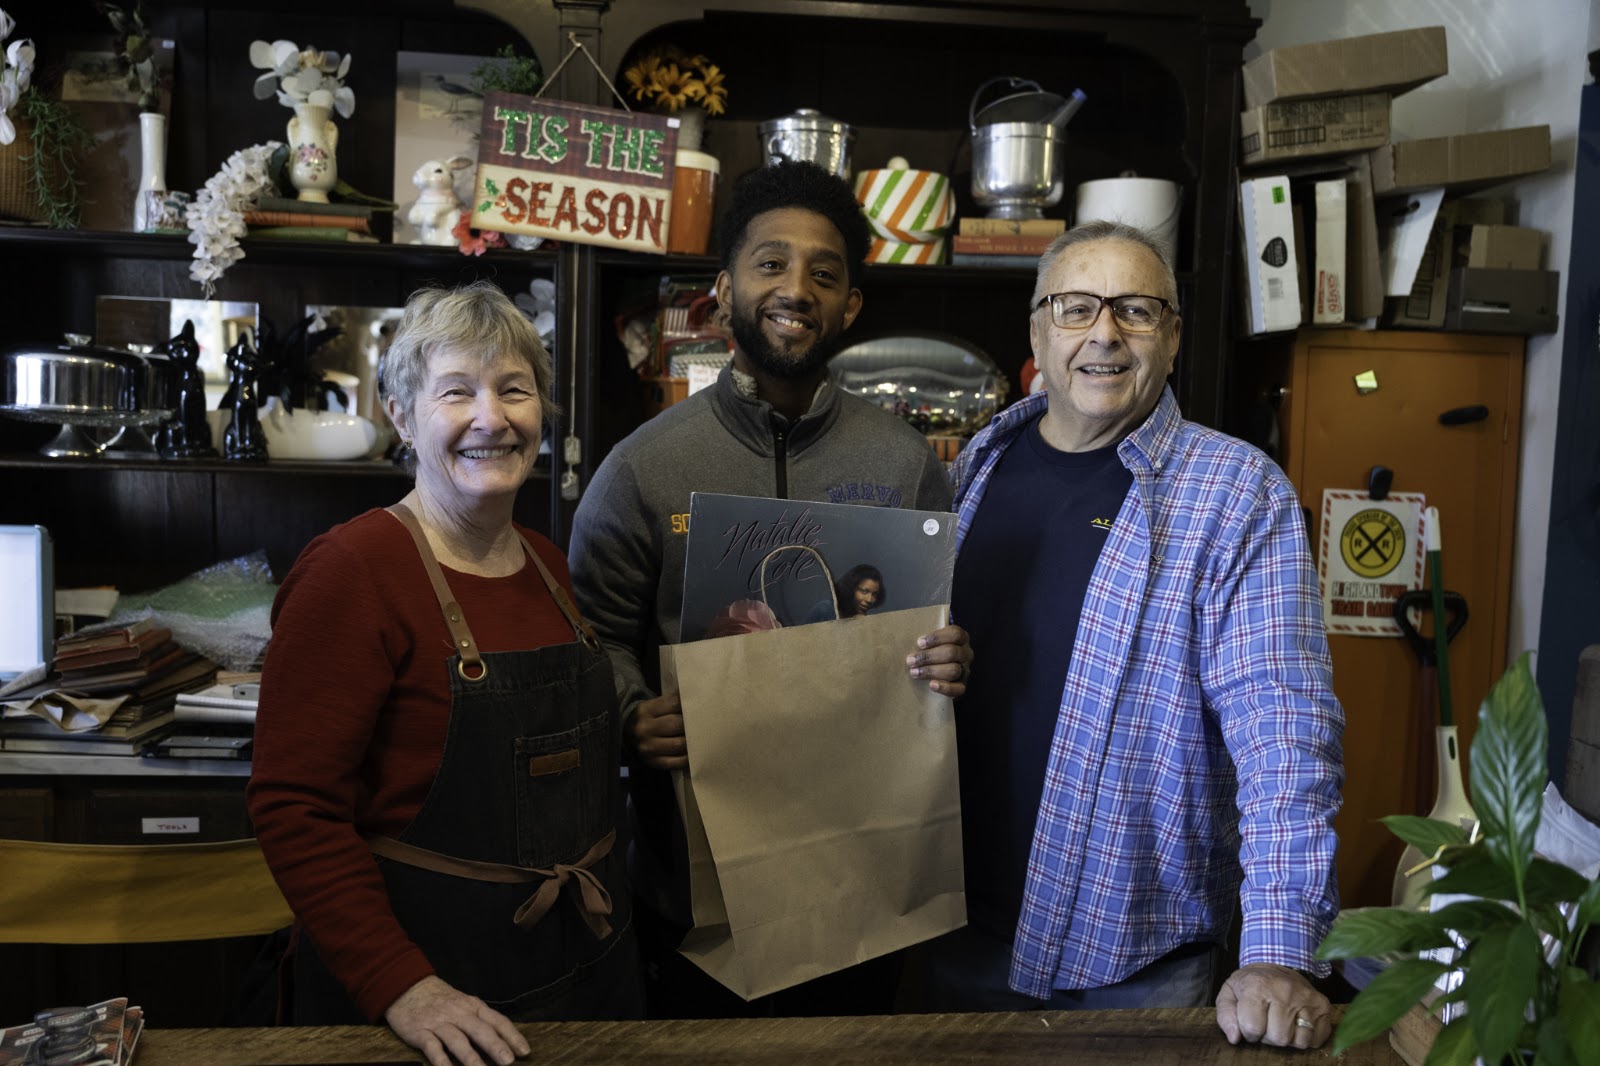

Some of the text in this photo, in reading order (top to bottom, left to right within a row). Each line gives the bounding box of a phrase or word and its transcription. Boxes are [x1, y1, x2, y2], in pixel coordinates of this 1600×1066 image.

[494, 106, 666, 179] TIS THE
[501, 177, 666, 250] SEASON
[827, 483, 902, 508] MERVO
[716, 508, 822, 573] Natalie
[748, 539, 829, 593] Cole
[1331, 599, 1364, 616] TRAIN
